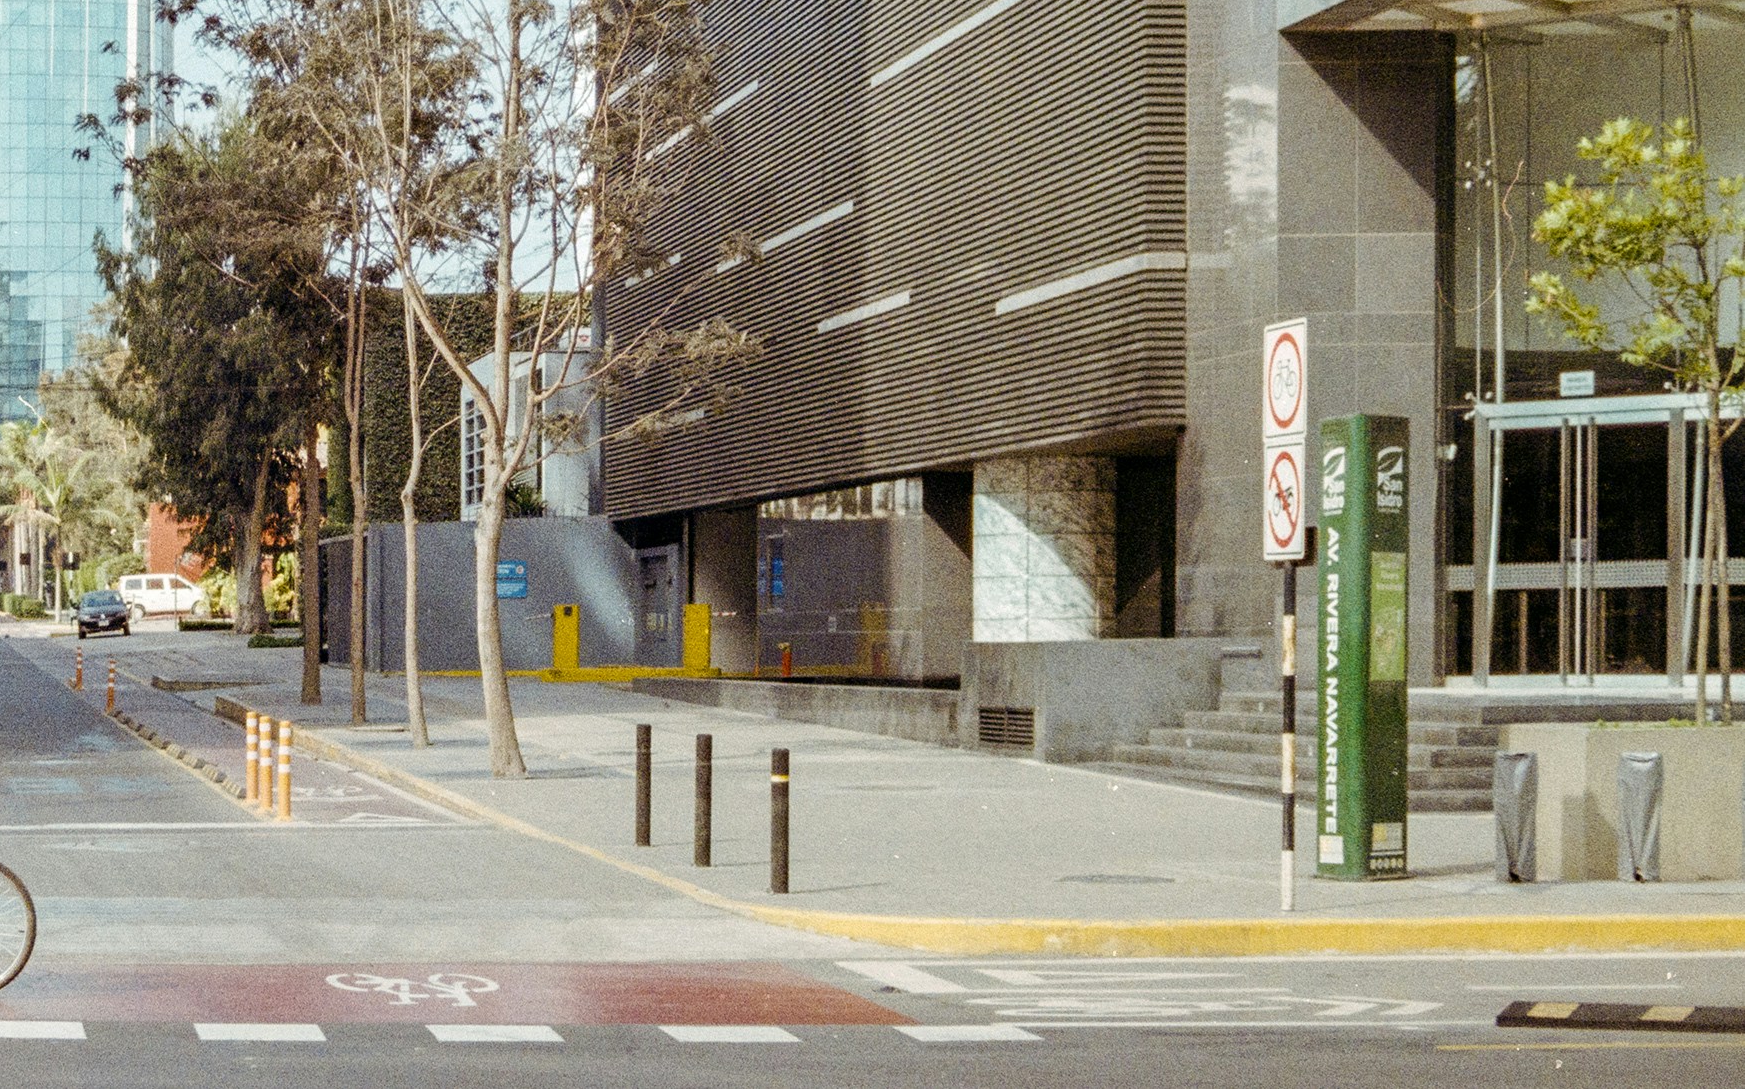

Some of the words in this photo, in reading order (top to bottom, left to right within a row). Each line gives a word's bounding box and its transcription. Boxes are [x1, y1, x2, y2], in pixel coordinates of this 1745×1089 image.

[1327, 526, 1340, 567] AV.
[1326, 573, 1339, 671] RIVERA
[1325, 677, 1339, 833] NAVARRETE
